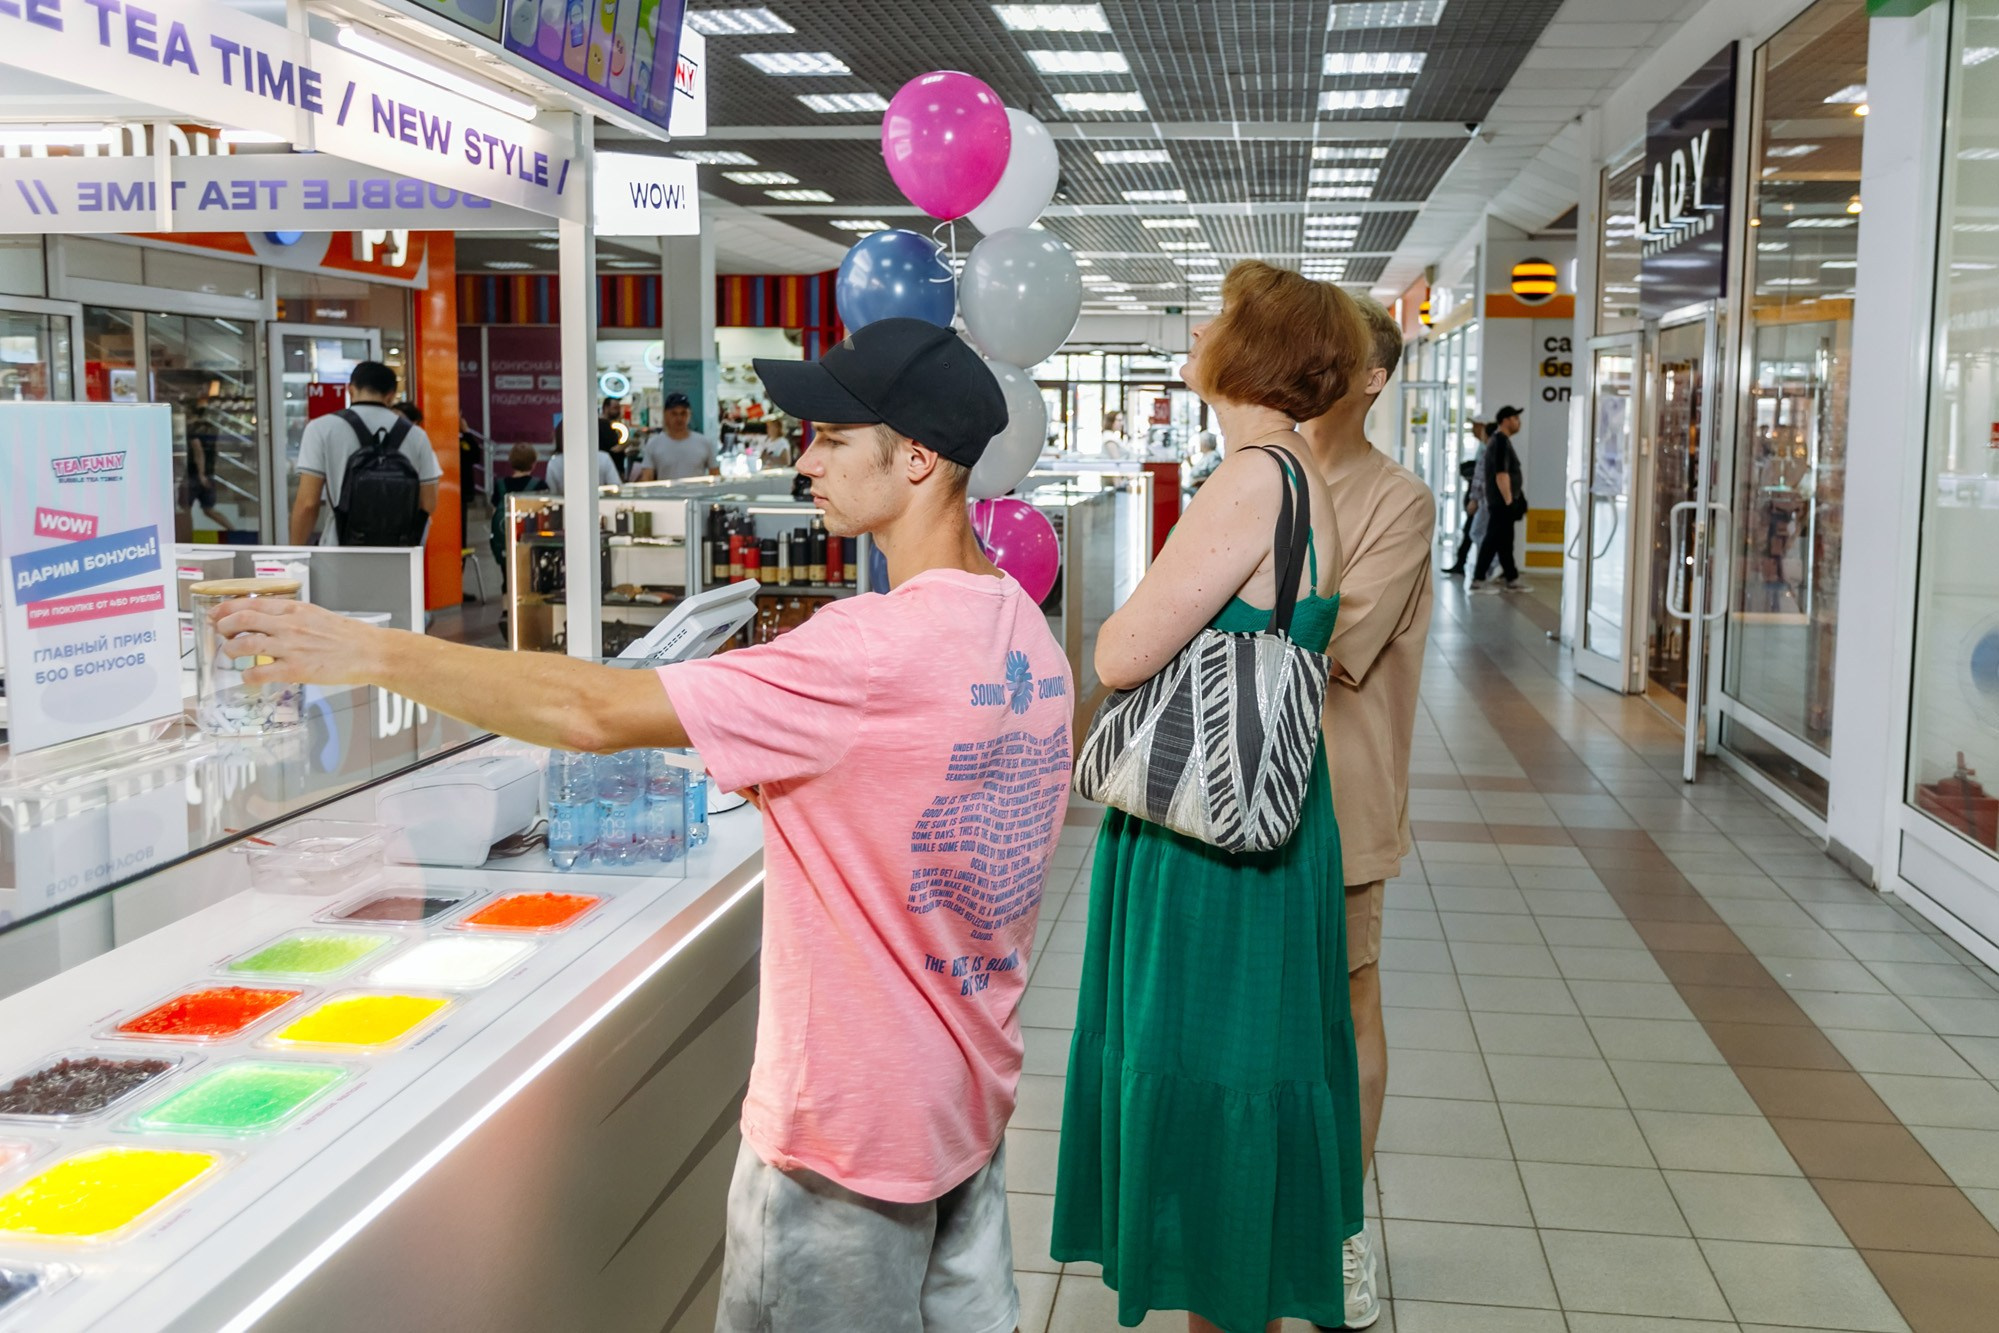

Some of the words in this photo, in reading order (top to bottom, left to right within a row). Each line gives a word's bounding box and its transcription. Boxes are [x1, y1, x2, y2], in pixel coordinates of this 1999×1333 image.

[84, 0, 200, 76] TEA
[210, 33, 324, 115] TIME
[371, 93, 452, 156] NEW
[464, 127, 549, 188] STYLE
[1634, 128, 1711, 239] LADY
[629, 182, 686, 210] WOW!
[39, 512, 93, 535] WOW!
[17, 559, 79, 590] ДАРИМ
[84, 537, 157, 571] БОНУСЫ!
[29, 609, 50, 619] ПРИ
[51, 602, 94, 615] ПОКУПКЕ
[96, 600, 108, 609] ОТ
[130, 591, 161, 604] РУБЛЕЙ
[34, 635, 108, 663] ГЛАВНЫЙ
[113, 630, 157, 649] ПРИЗ!
[36, 667, 69, 685] 500
[74, 653, 146, 678] БОНУСОВ
[953, 743, 974, 752] UNDER
[948, 763, 977, 771] BIRDSONG
[950, 754, 977, 762] BLOWING
[945, 773, 977, 781] SEARCHING
[931, 795, 949, 805] THIS
[948, 795, 958, 805] IS
[958, 793, 971, 803] THE
[922, 808, 943, 818] GOOD
[943, 806, 960, 817] AND
[961, 803, 975, 813] THIS
[975, 803, 981, 811] IS
[915, 820, 930, 830] THE
[931, 819, 949, 828] SUN
[949, 817, 958, 826] IS
[959, 814, 982, 824] SHINING
[911, 831, 932, 840] SOME
[959, 826, 973, 836] THIS
[973, 826, 980, 836] IS
[937, 841, 960, 852] SOME
[960, 840, 976, 852] GOOD
[912, 869, 922, 879] THE
[922, 868, 939, 877] DAYS
[940, 868, 953, 877] GET
[954, 870, 977, 884] LONGER
[930, 879, 943, 887] AND
[943, 880, 962, 890] WAKE
[962, 884, 973, 895] ME
[972, 888, 980, 897] UP
[908, 895, 916, 903] IN
[929, 889, 954, 899] EVENING
[956, 894, 978, 910] GIFTING
[935, 899, 943, 907] OF
[942, 900, 965, 915] COLORS
[964, 911, 993, 930] REFLECTING
[970, 929, 993, 941] CLOUDS.
[925, 953, 947, 974] THE
[971, 956, 984, 972] IS
[960, 978, 973, 996] BY
[974, 973, 990, 993] SEA
